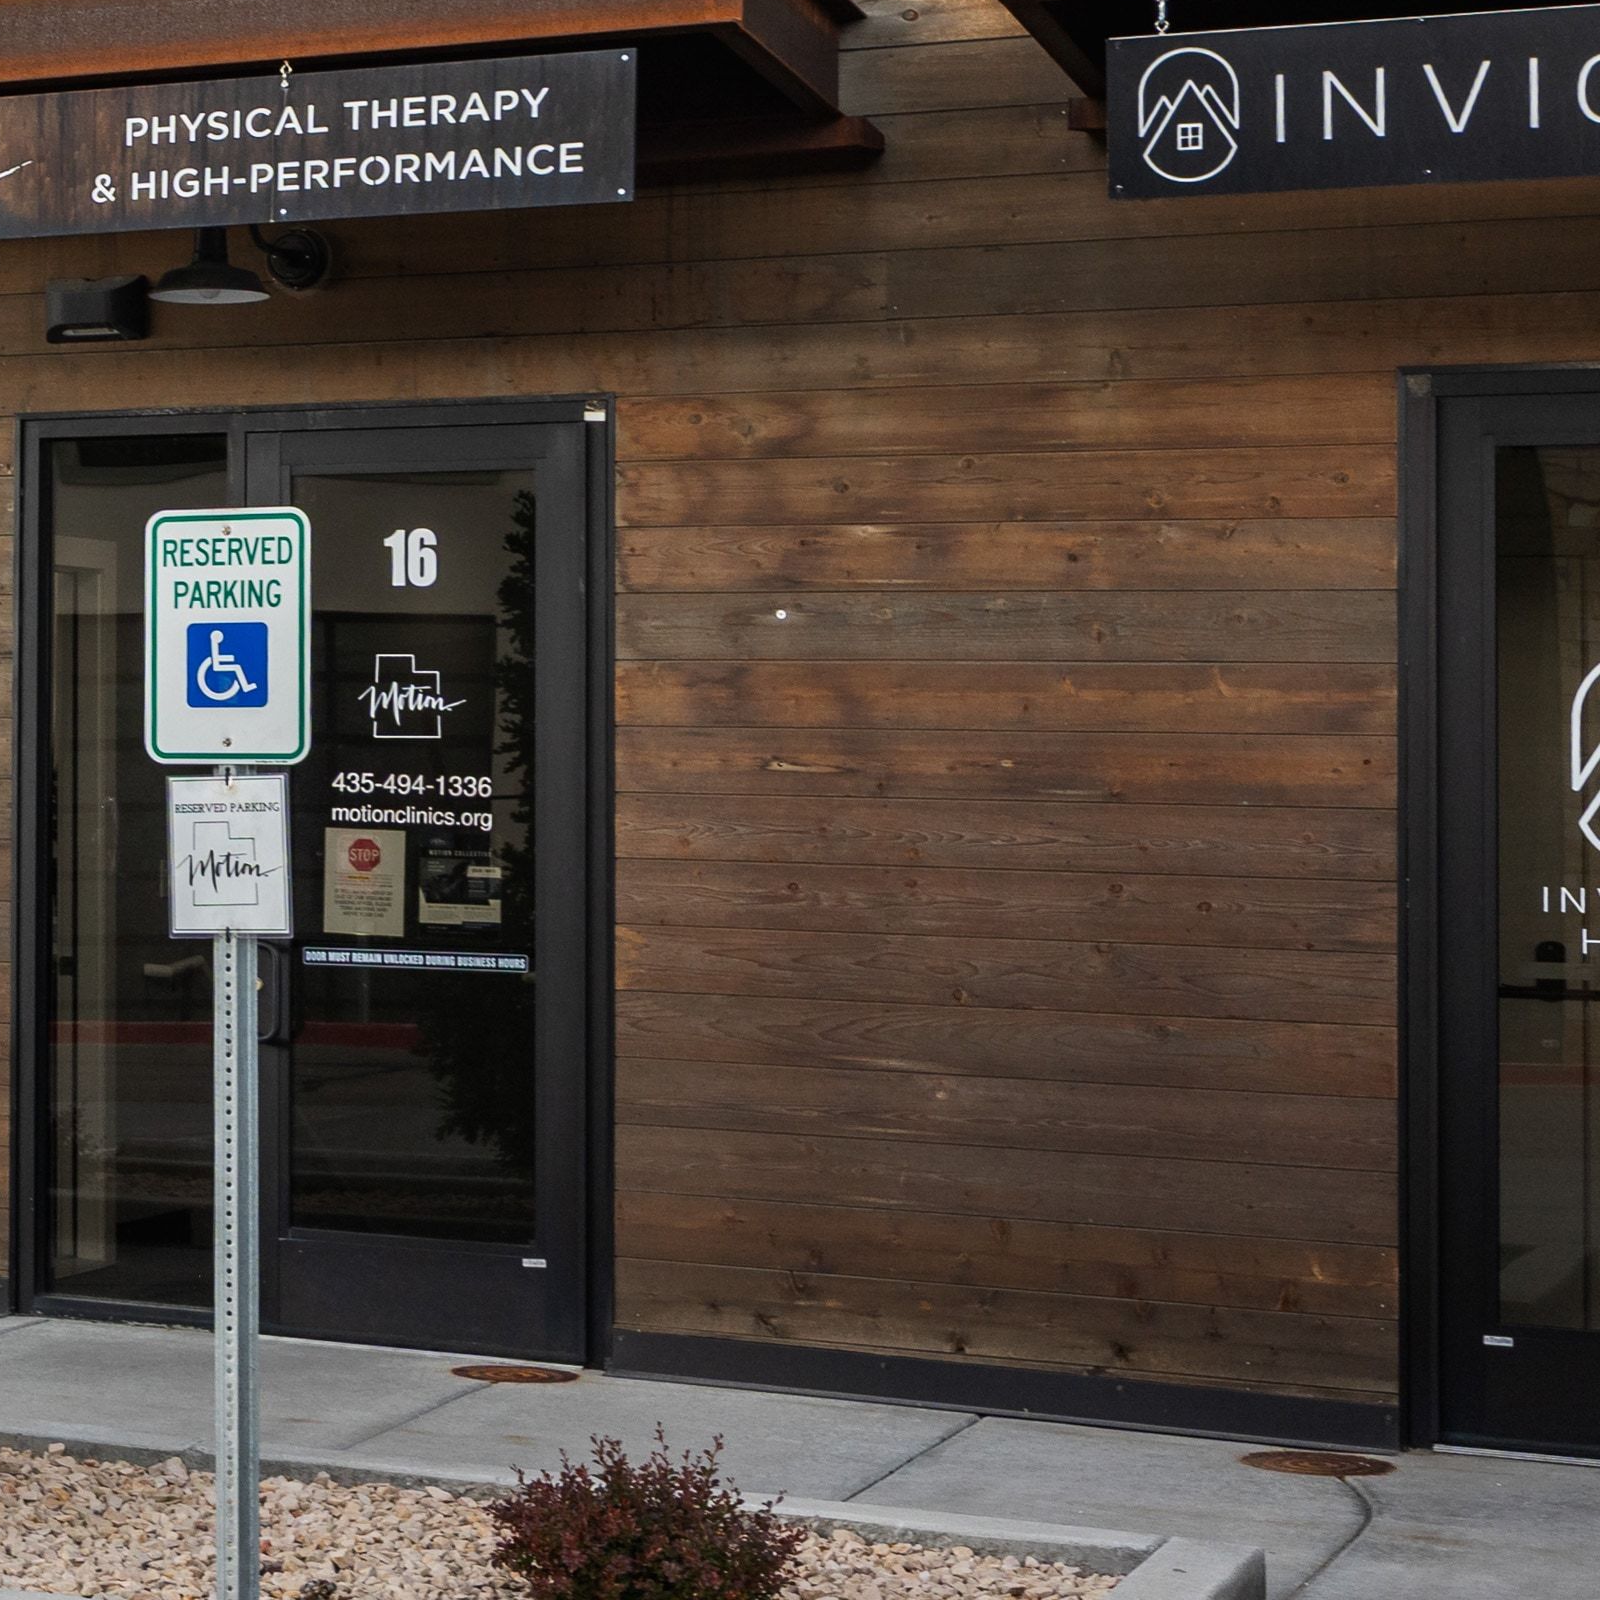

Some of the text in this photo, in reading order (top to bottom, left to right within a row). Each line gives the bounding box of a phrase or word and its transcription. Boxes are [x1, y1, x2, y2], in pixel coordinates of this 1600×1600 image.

[125, 87, 549, 147] PHYSICAL THERAPY
[88, 141, 585, 205] & HIGH-PERFORMANCE
[162, 536, 293, 567] RESERVED
[383, 527, 438, 587] 16
[174, 579, 282, 609] PARKING
[357, 680, 468, 726] Motion
[331, 772, 493, 798] 435-494-1336
[175, 802, 281, 814] RESERVED PARKING
[331, 804, 494, 831] motionclinics.org
[349, 848, 380, 862] STOP
[176, 849, 283, 893] Motion
[1542, 886, 1600, 914] IN
[305, 950, 526, 969] DOOR MUST REMAIN UNLOCKED DURING BUSINESS HOURS
